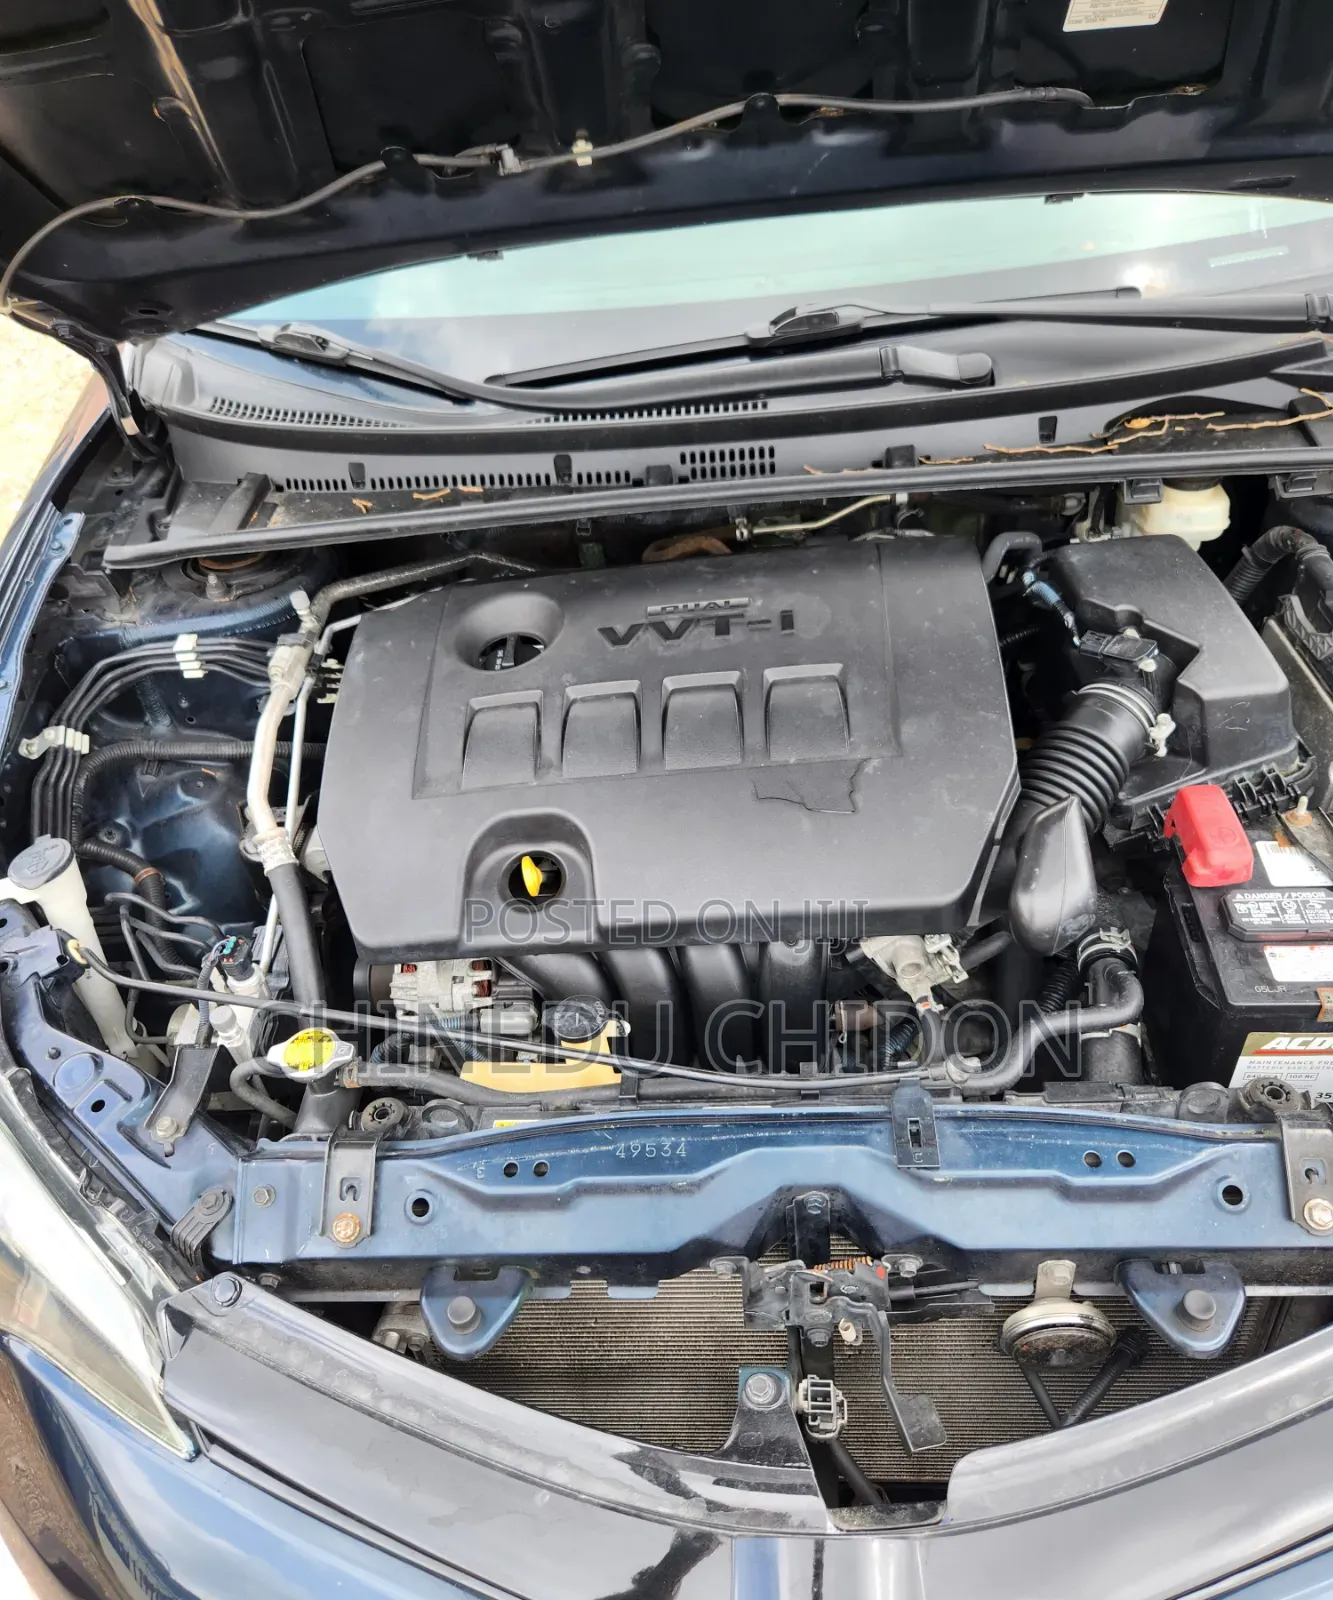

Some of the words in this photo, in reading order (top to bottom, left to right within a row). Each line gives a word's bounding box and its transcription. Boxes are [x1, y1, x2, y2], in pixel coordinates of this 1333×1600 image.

[660, 599, 740, 614] DUAL
[1244, 892, 1282, 900] DANGER
[1291, 891, 1326, 899] POISON
[1260, 1036, 1333, 1050] ACD
[615, 1142, 687, 1159] 49534
